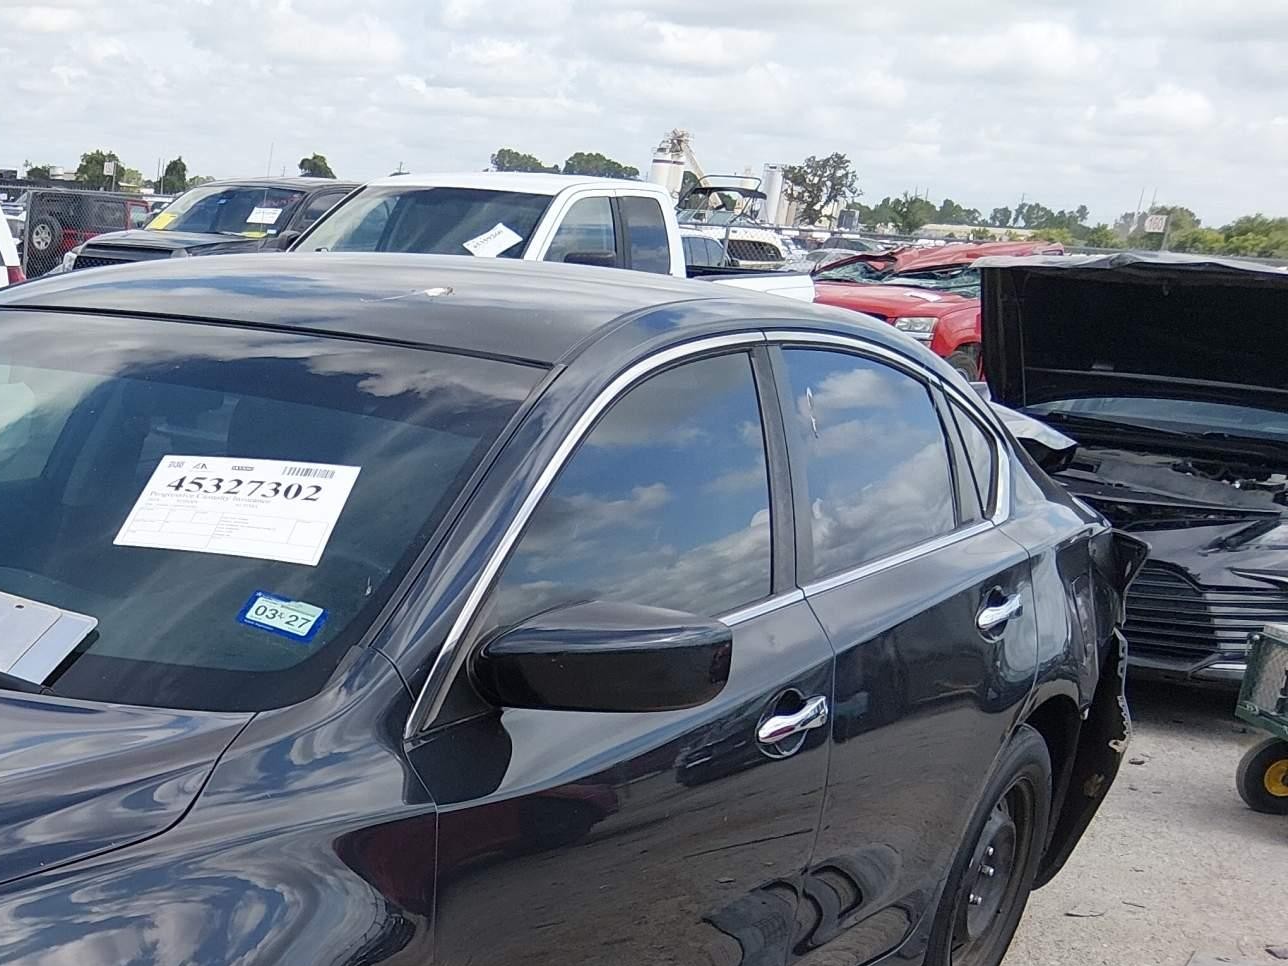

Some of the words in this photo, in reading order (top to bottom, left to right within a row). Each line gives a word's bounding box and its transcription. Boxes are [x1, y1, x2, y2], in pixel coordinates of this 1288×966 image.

[166, 475, 323, 502] 45327302
[254, 604, 279, 620] 03
[284, 614, 312, 629] 27
